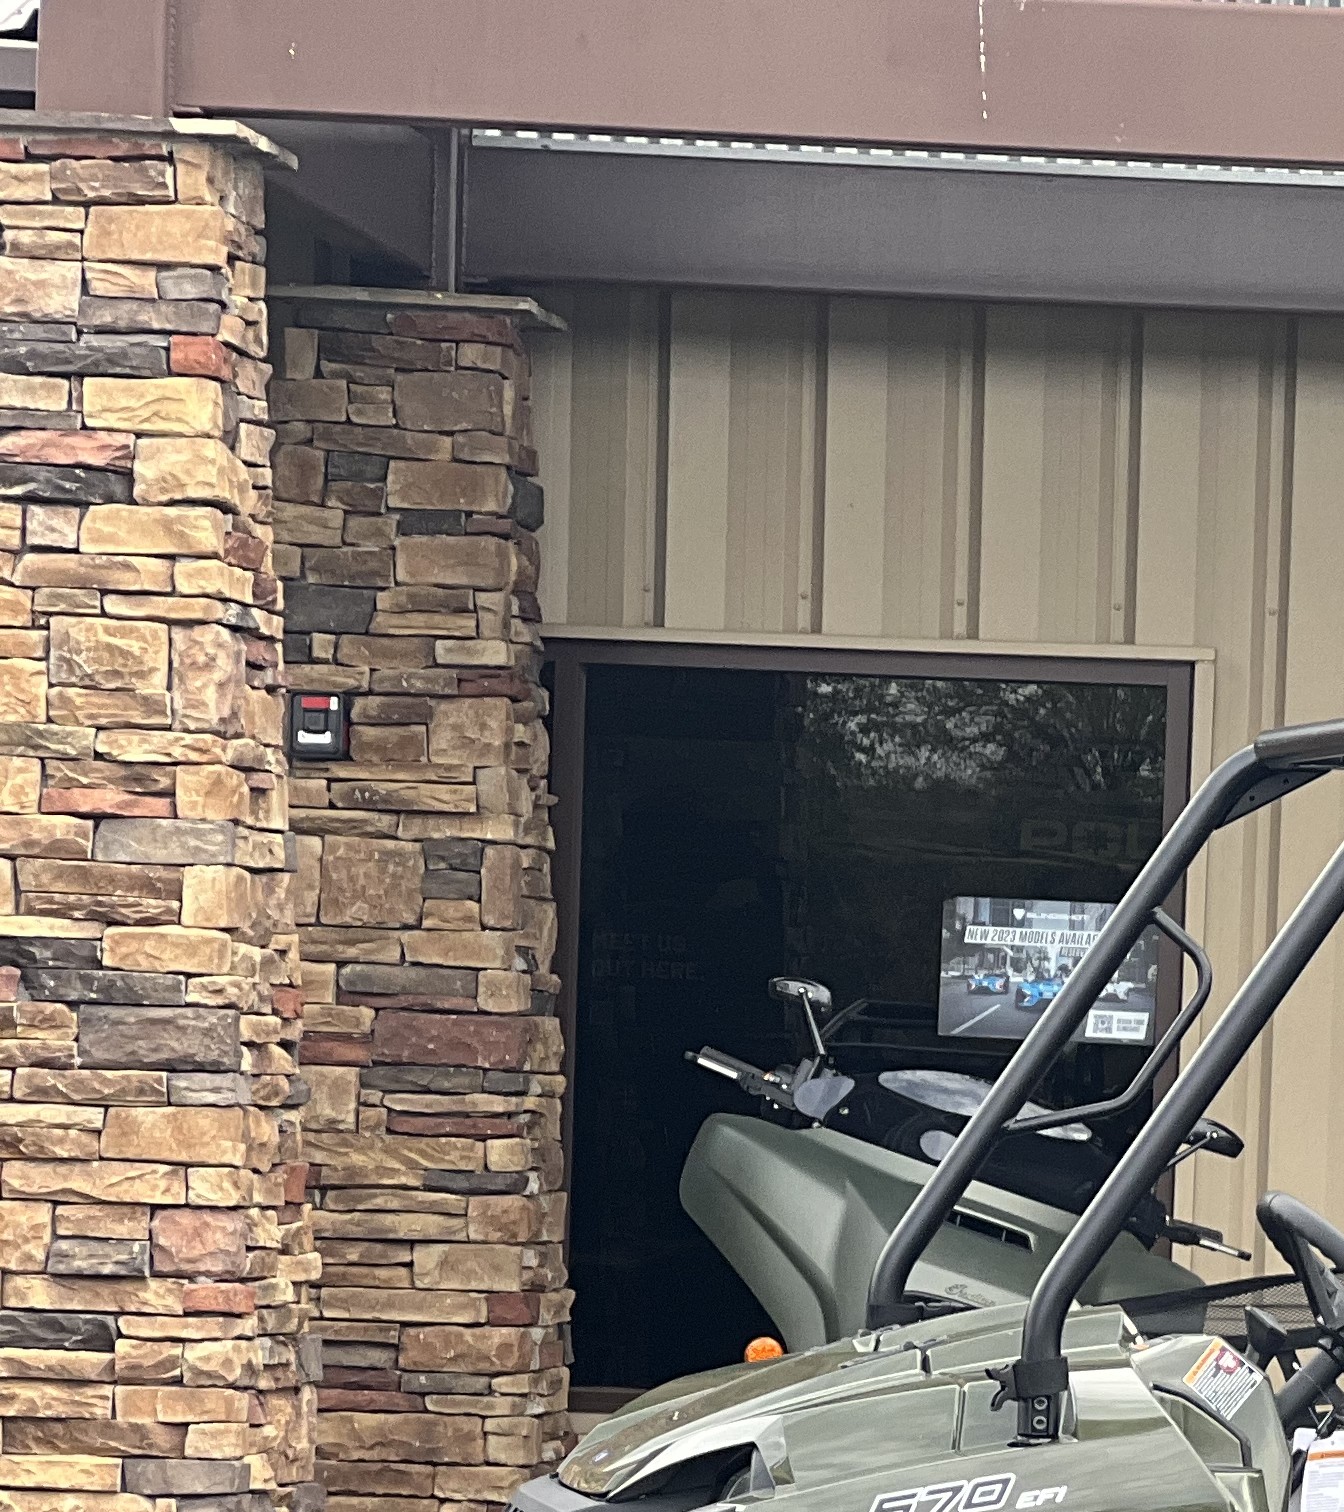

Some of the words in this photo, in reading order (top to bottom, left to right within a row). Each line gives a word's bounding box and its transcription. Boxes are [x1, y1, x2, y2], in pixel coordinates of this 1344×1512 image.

[966, 928, 989, 942] NEW
[991, 929, 1016, 943] 2023
[1018, 930, 1056, 945] MODELS
[1015, 1485, 1068, 1510] EFI
